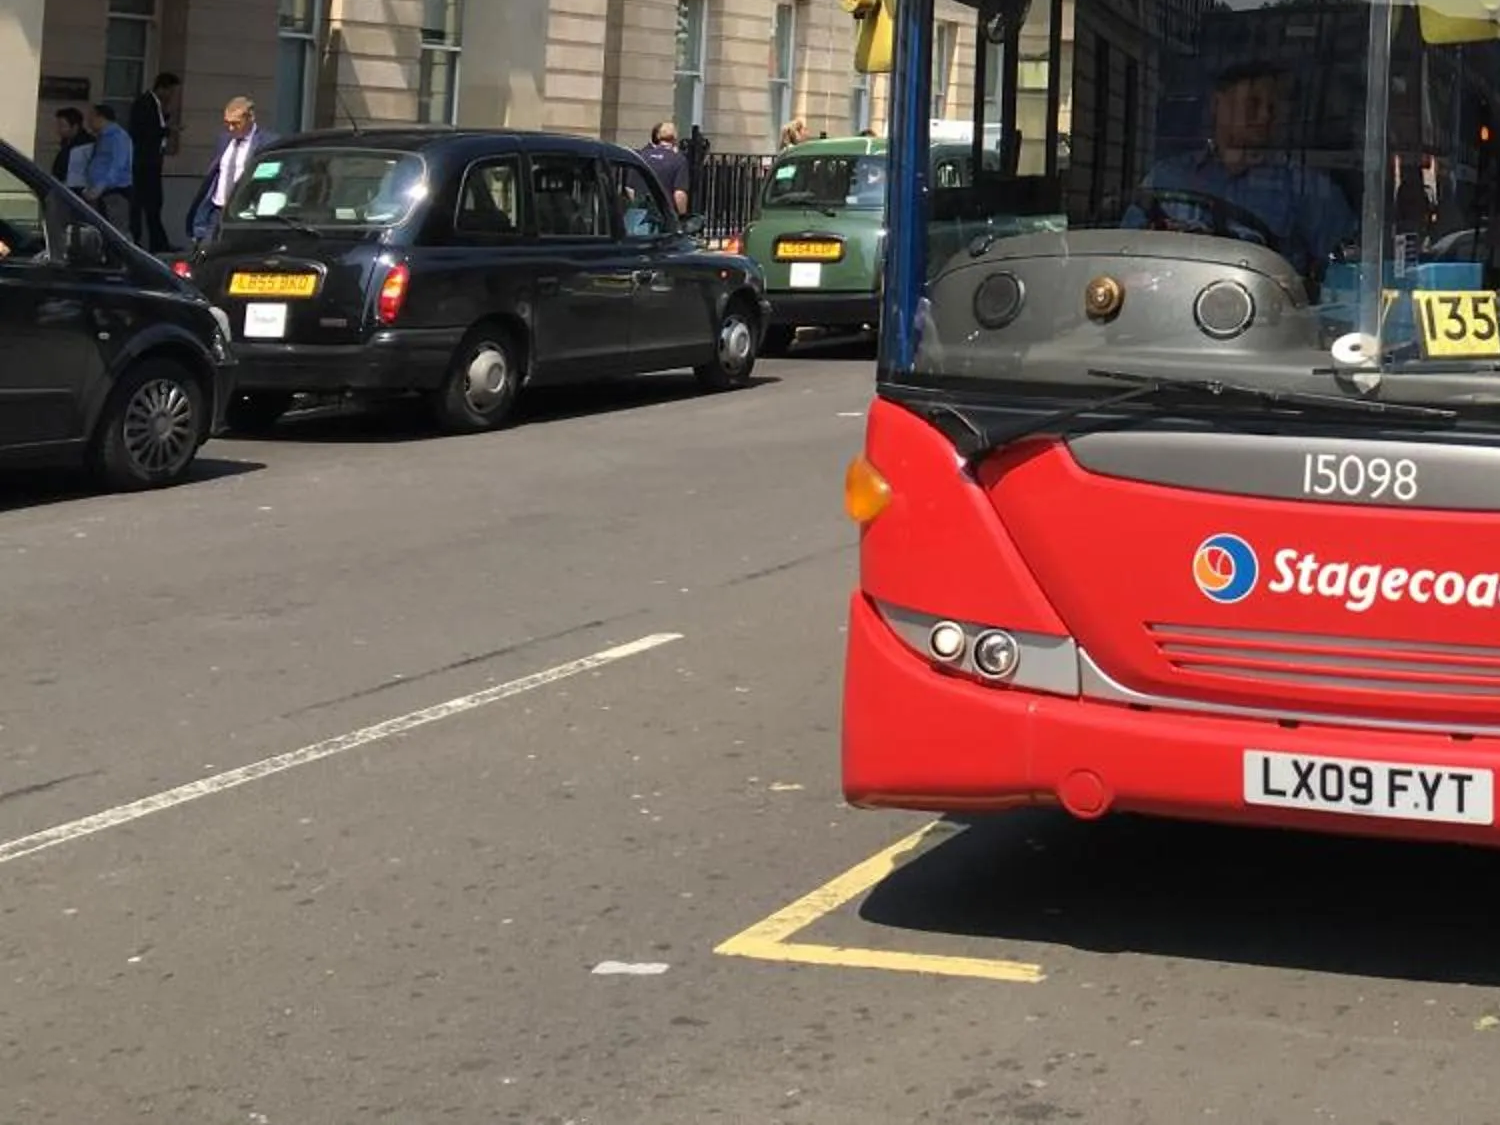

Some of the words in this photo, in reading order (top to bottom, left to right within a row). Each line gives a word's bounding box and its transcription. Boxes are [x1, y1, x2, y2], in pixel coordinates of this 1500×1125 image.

[1425, 296, 1497, 342] 135
[1303, 453, 1418, 501] 15098
[1263, 756, 1373, 806] LX09
[1388, 768, 1473, 814] FYT
